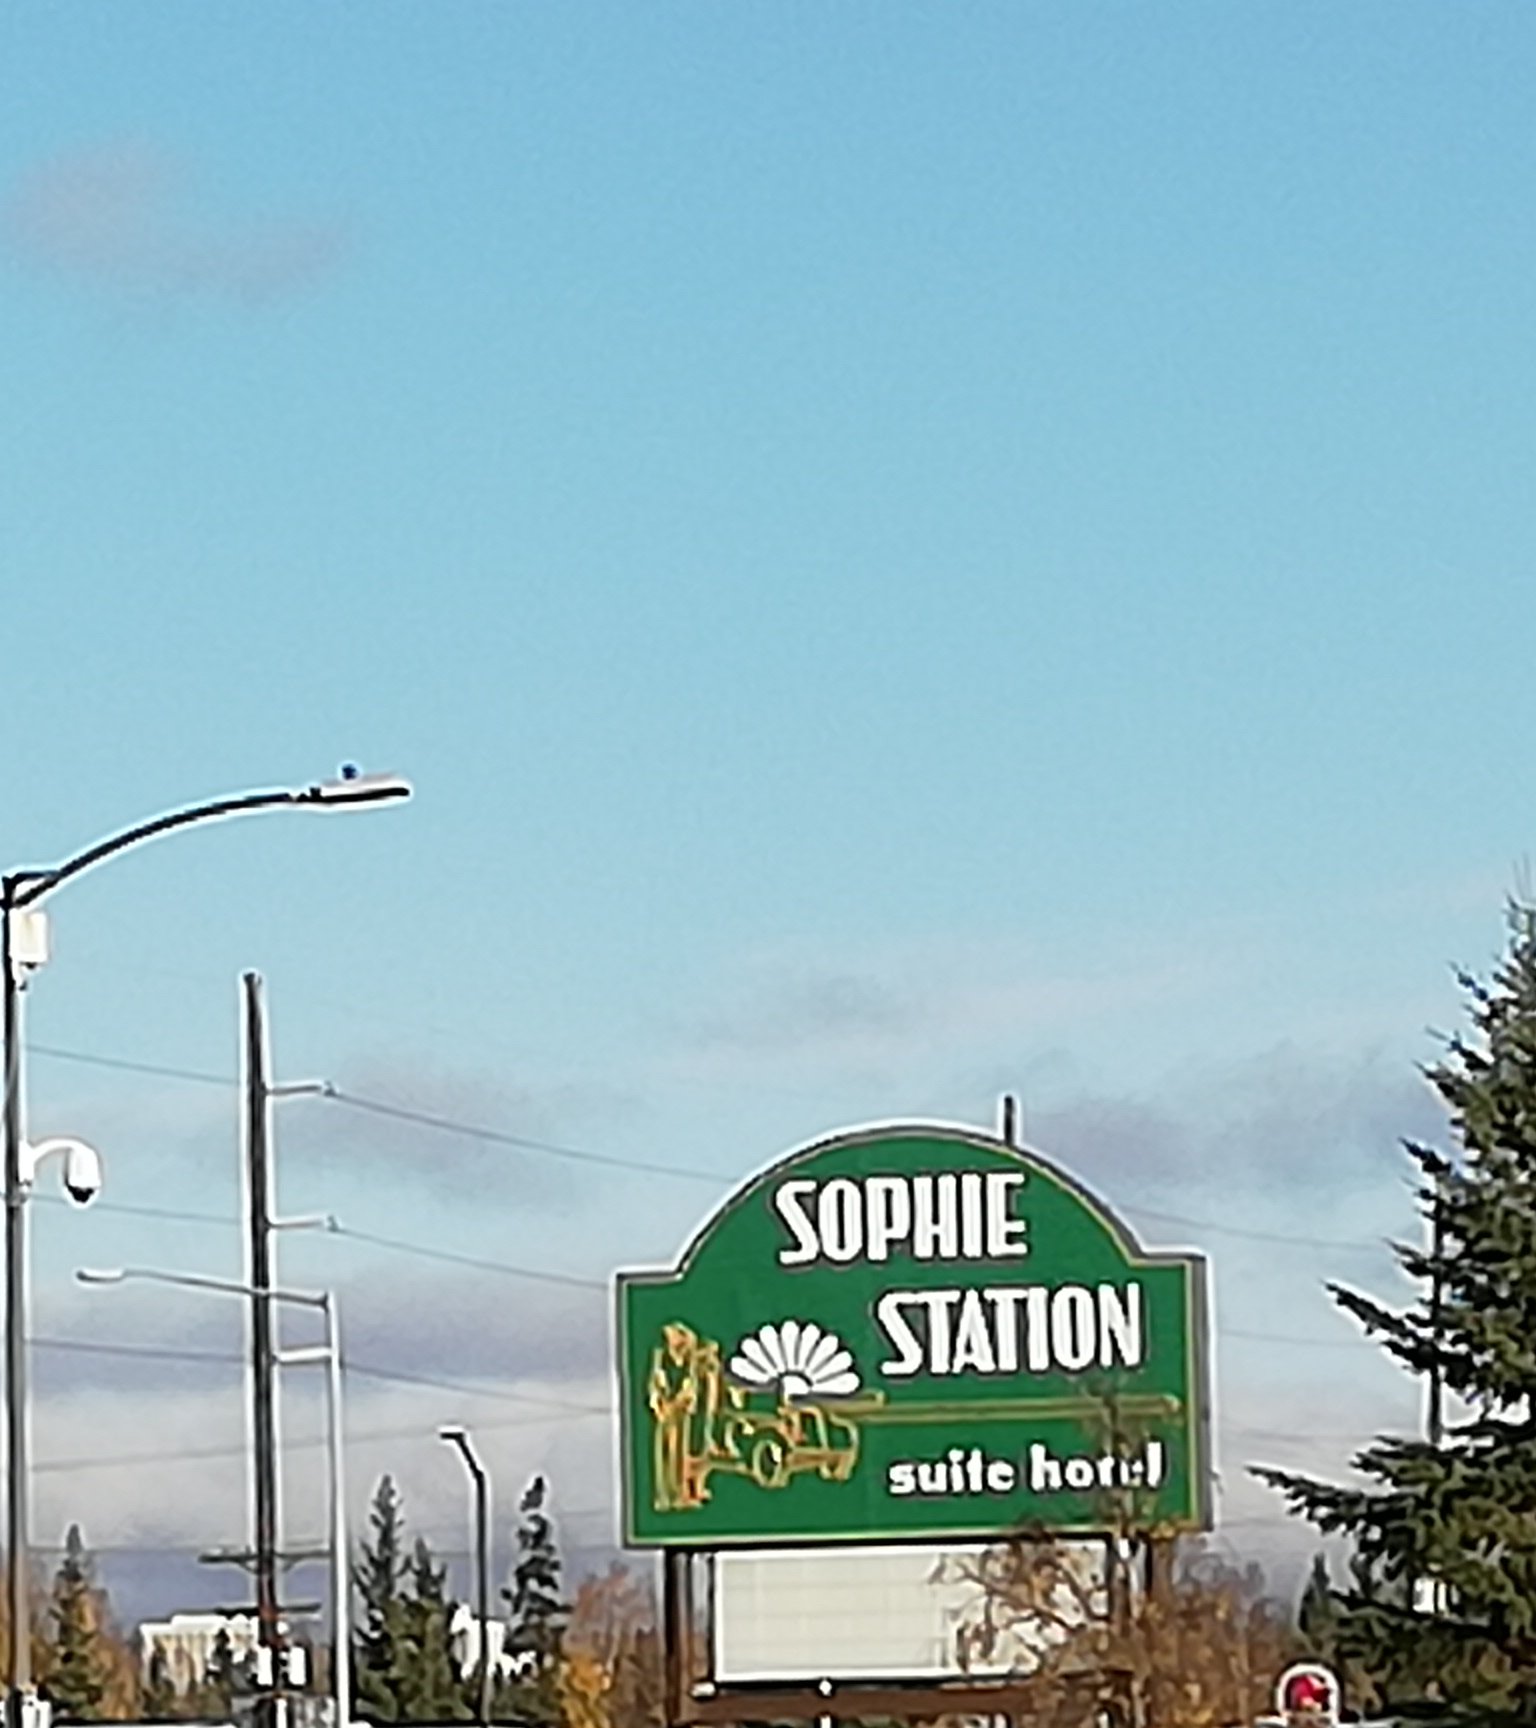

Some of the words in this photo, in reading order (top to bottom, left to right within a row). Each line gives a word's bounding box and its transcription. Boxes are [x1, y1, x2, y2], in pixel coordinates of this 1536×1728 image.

[775, 1173, 1028, 1264] SOPHIE
[877, 1283, 1141, 1375] STATION
[889, 1448, 1014, 1493] suite
